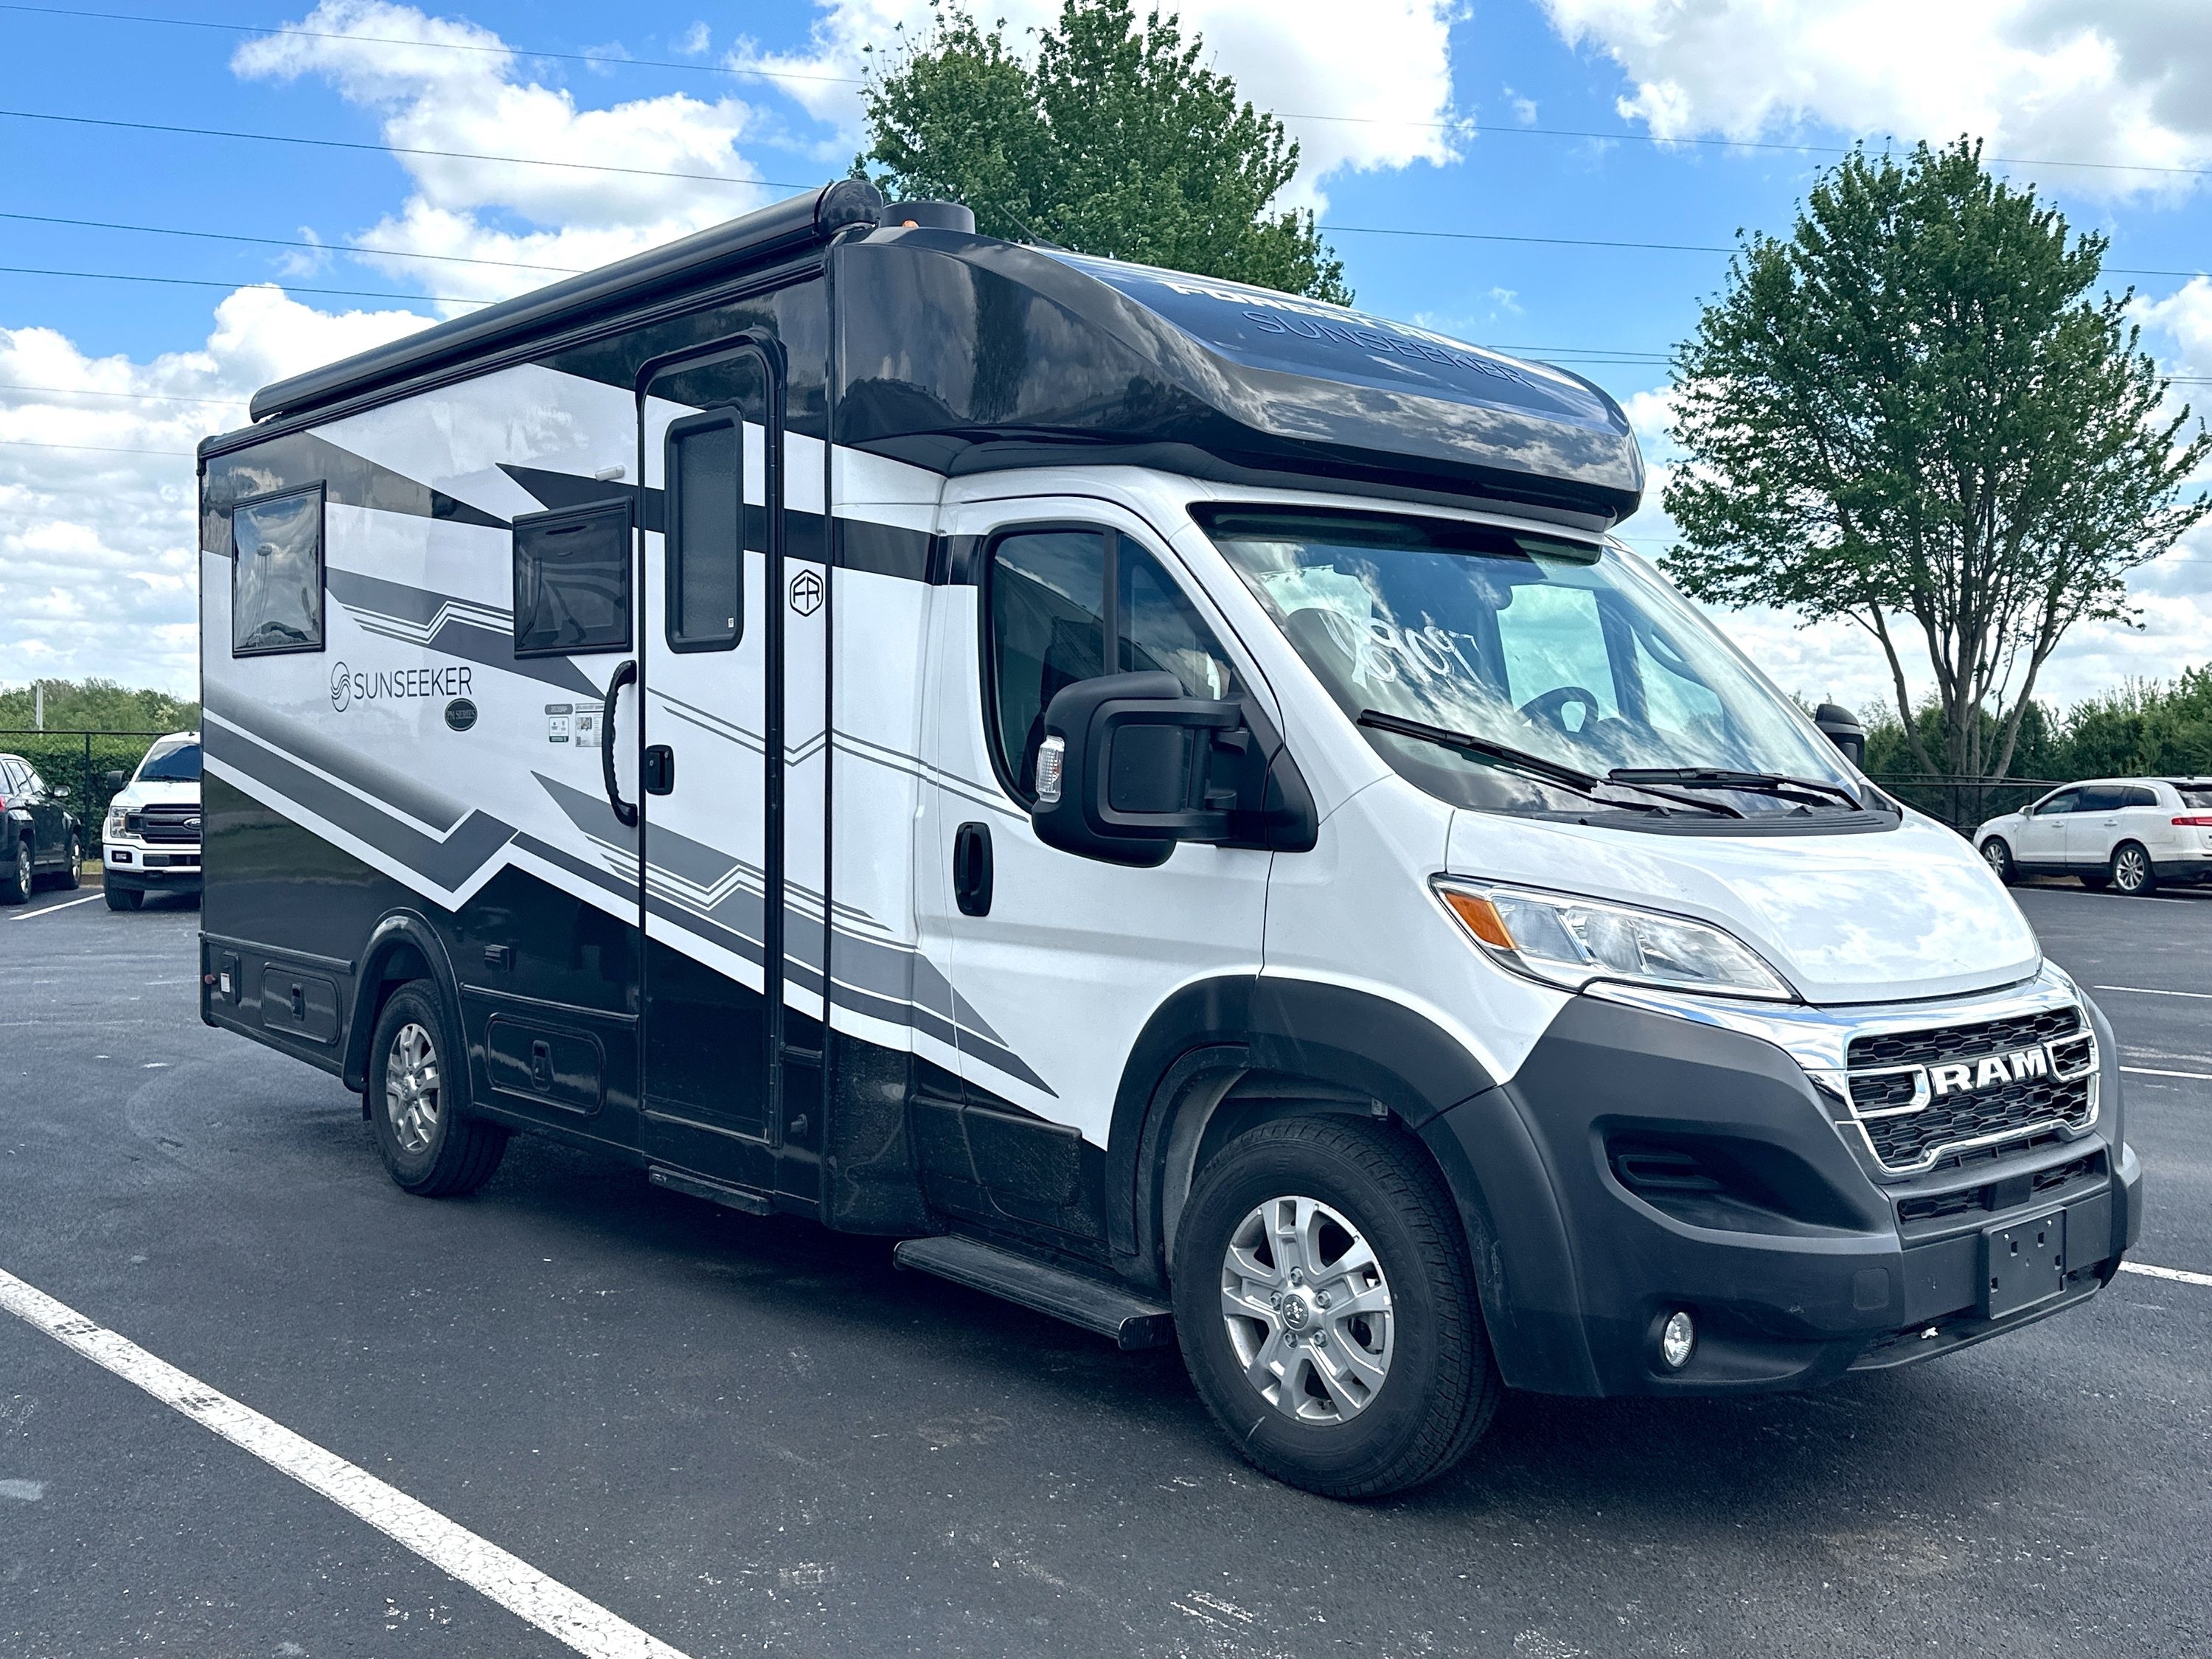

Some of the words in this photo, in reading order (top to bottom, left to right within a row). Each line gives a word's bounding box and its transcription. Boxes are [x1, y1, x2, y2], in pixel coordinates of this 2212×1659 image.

[1242, 310, 1536, 389] SUNSEEKER
[353, 667, 473, 700] SUNSEEKER
[1928, 1048, 2048, 1096] RAM
